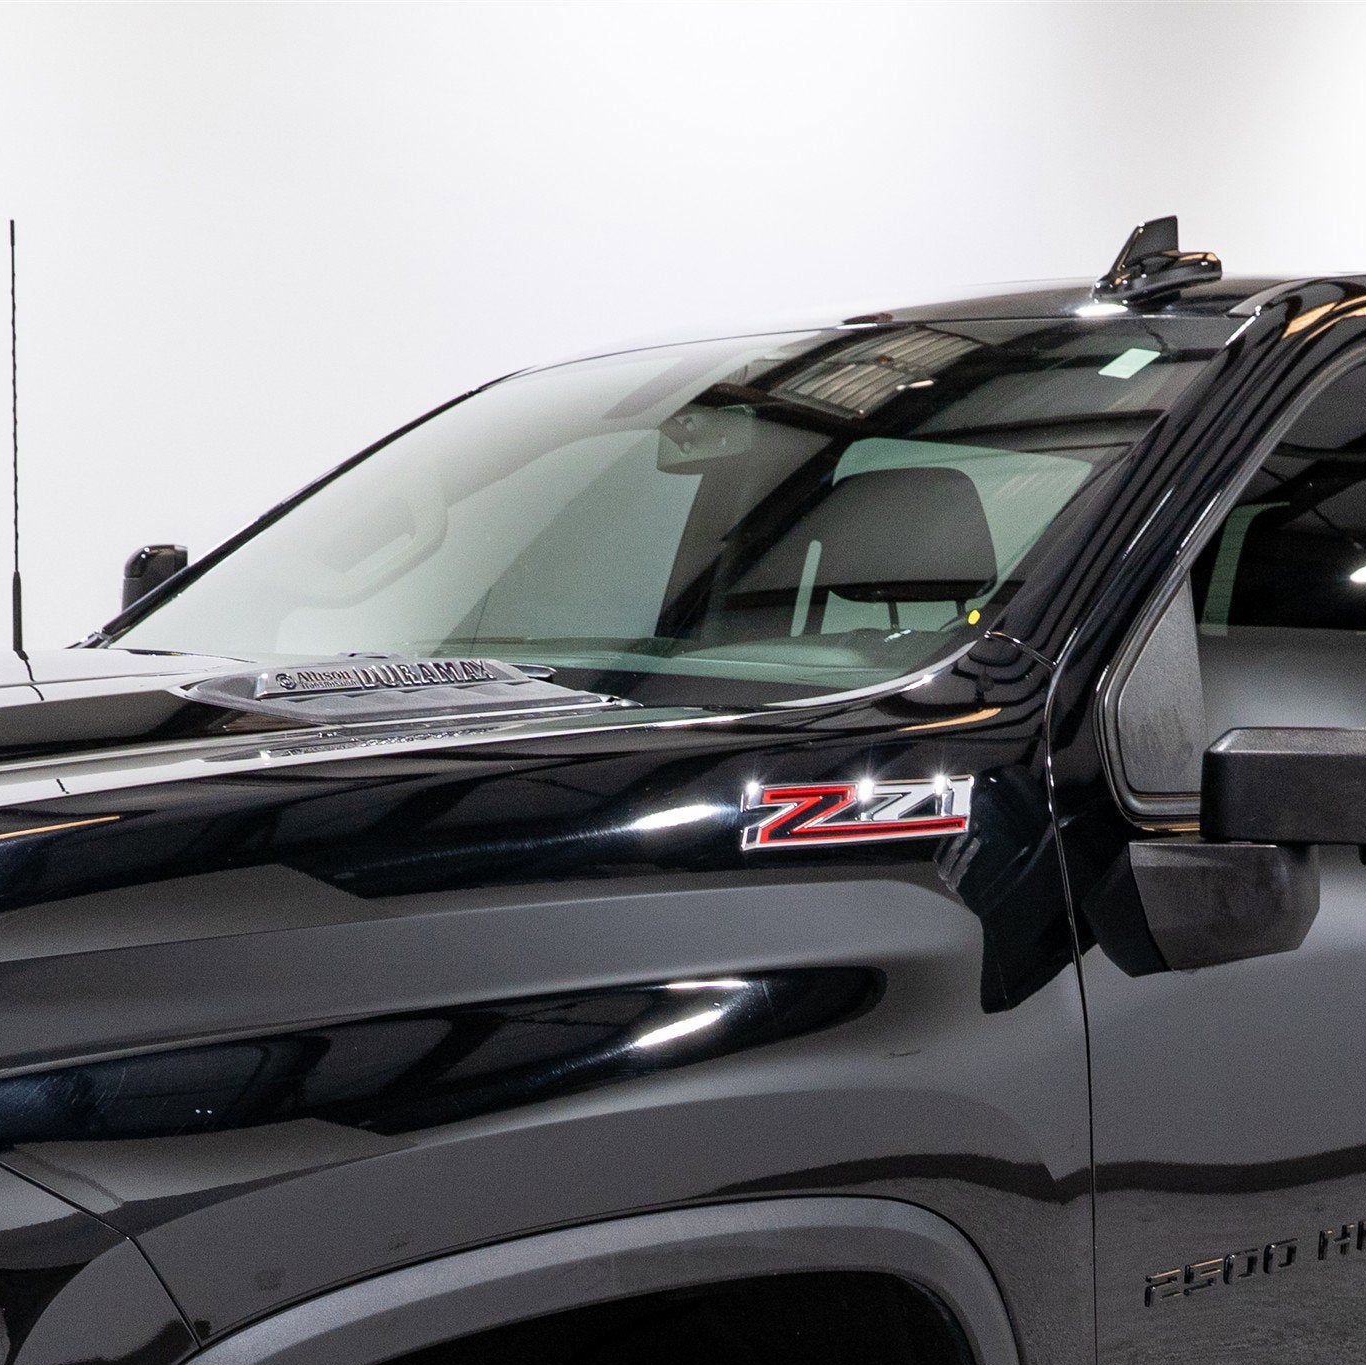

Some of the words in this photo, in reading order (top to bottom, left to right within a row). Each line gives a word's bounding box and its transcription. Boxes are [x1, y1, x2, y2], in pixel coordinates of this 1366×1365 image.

[296, 670, 352, 682] Allison
[353, 659, 499, 690] DURAMAX
[740, 774, 976, 851] Z71
[1143, 1238, 1299, 1307] 2500
